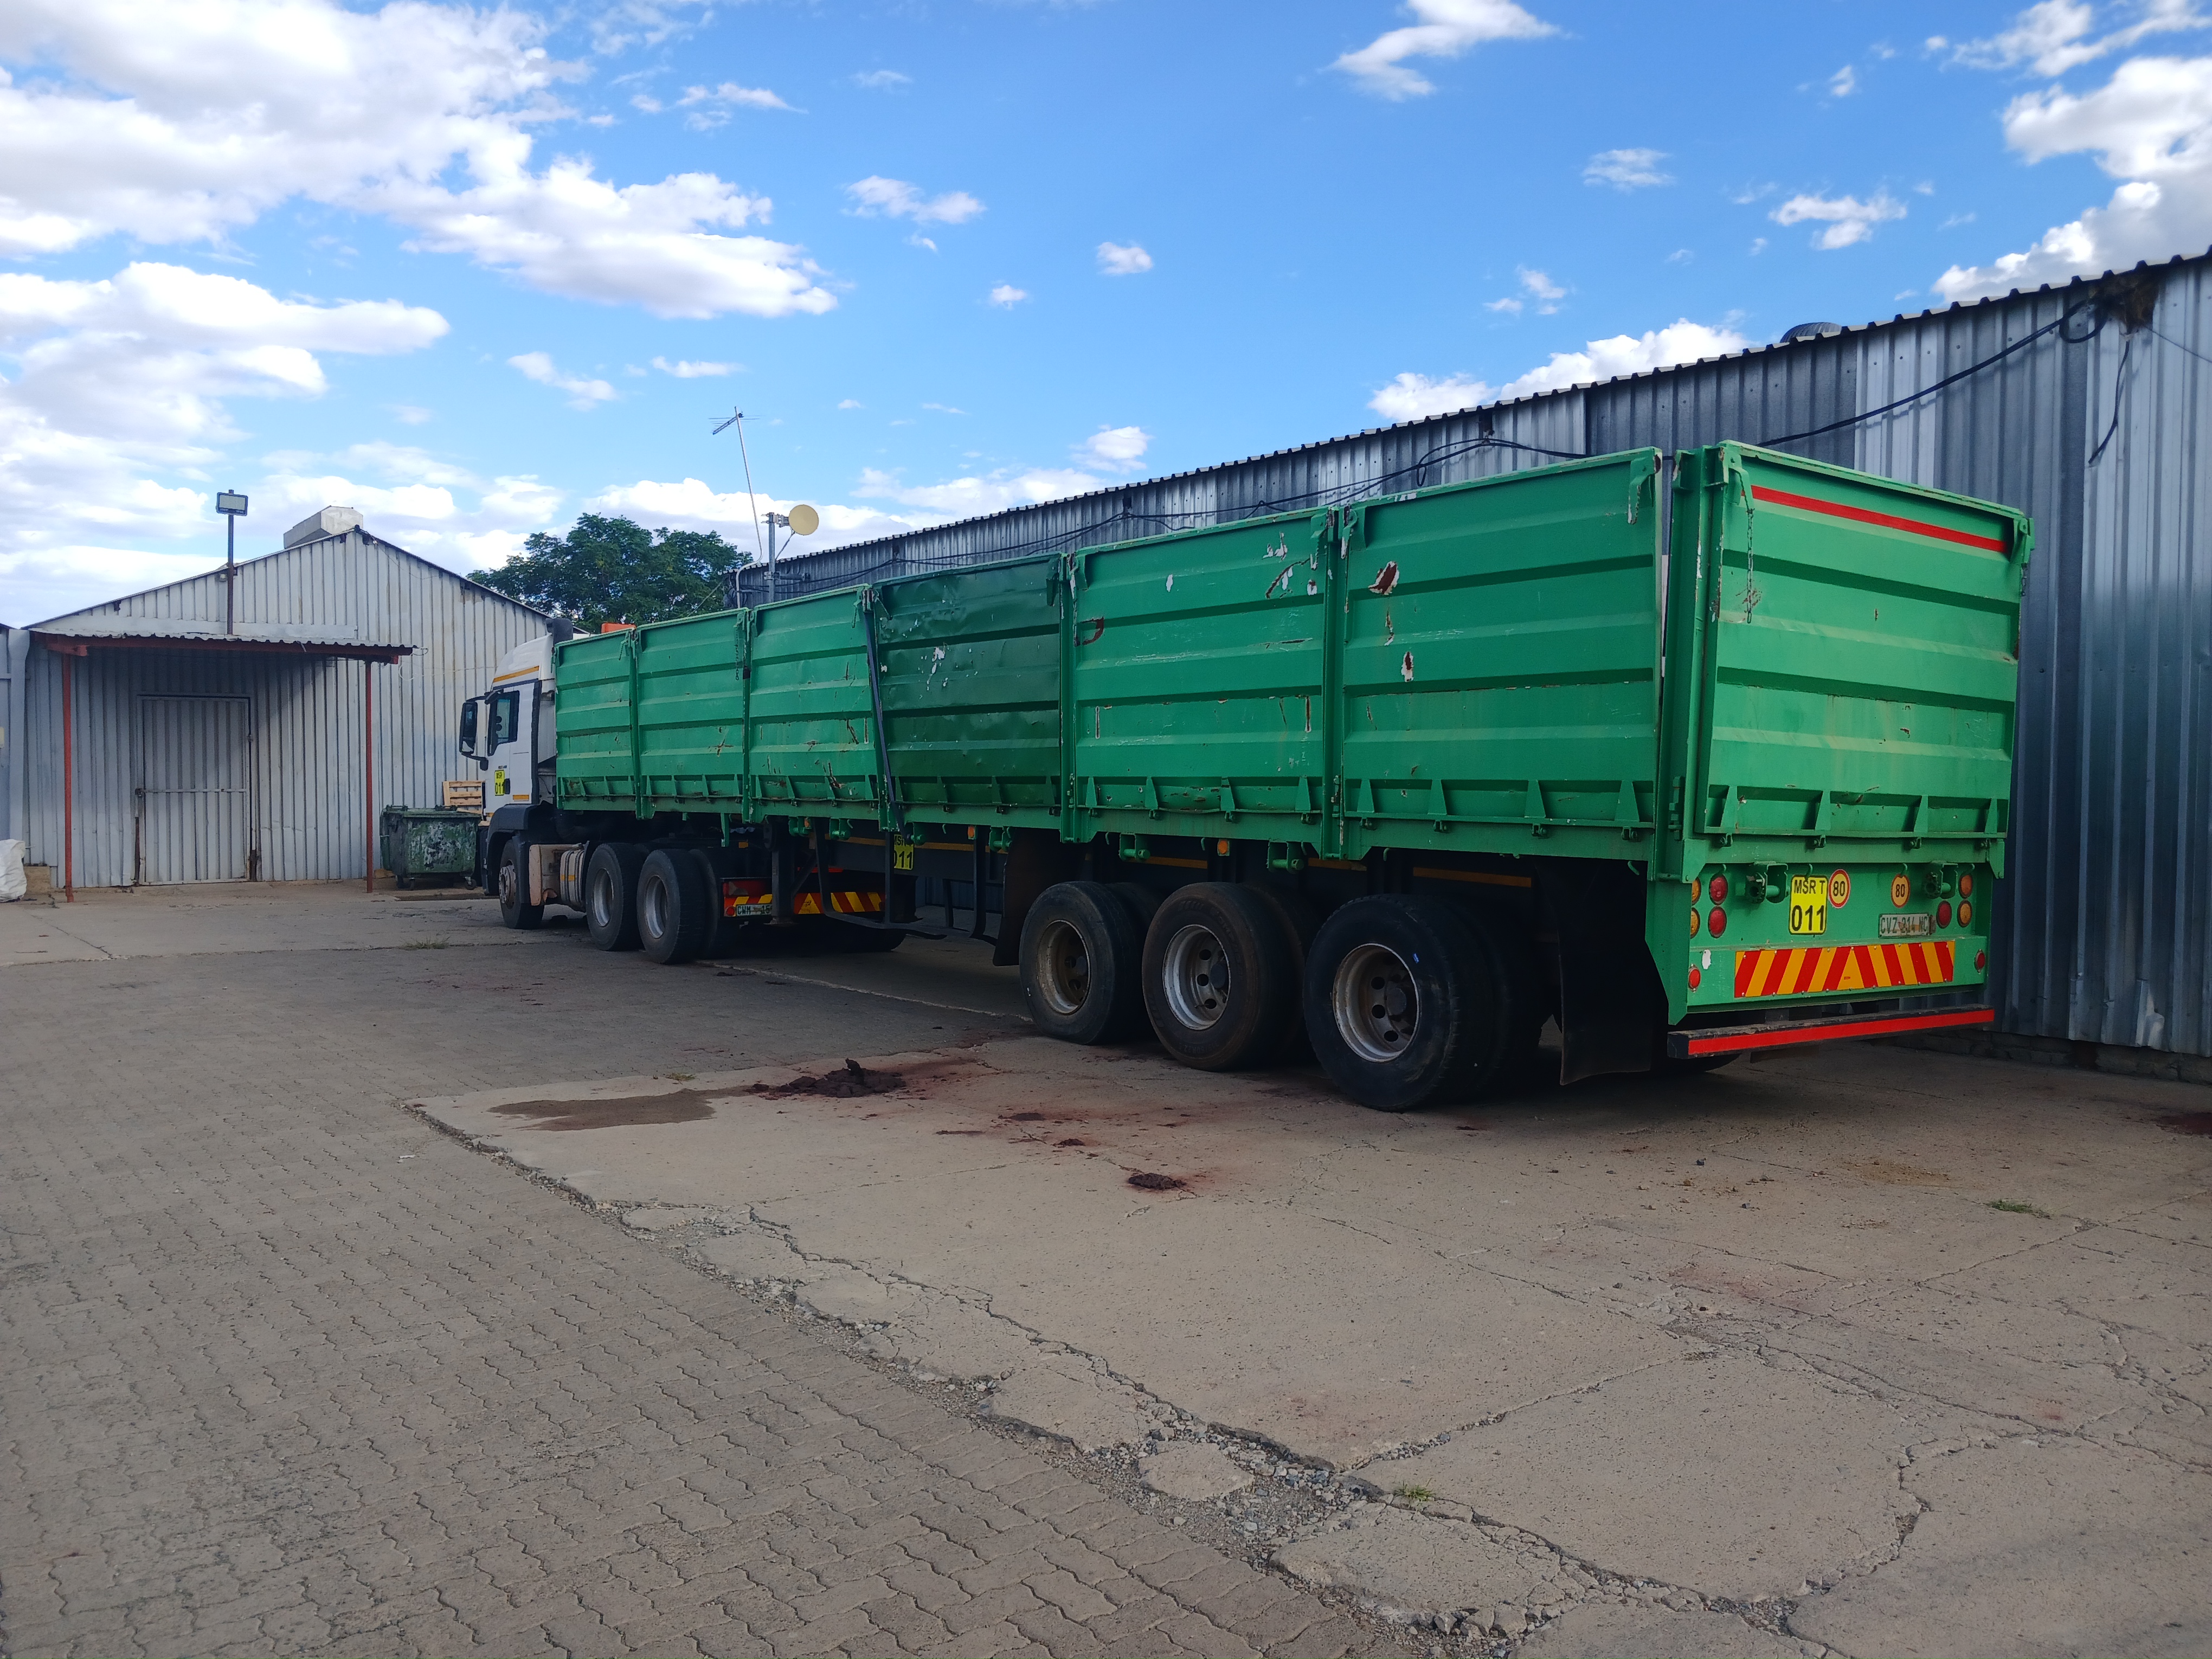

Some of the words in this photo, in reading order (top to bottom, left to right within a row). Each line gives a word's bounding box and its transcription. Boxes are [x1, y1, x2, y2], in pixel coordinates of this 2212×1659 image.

[1794, 879, 1816, 895] MSR
[1819, 880, 1826, 895] T
[1832, 880, 1846, 897] 80
[1895, 884, 1906, 898] 80
[1791, 905, 1824, 931] 011
[1880, 917, 1898, 934] CVZ
